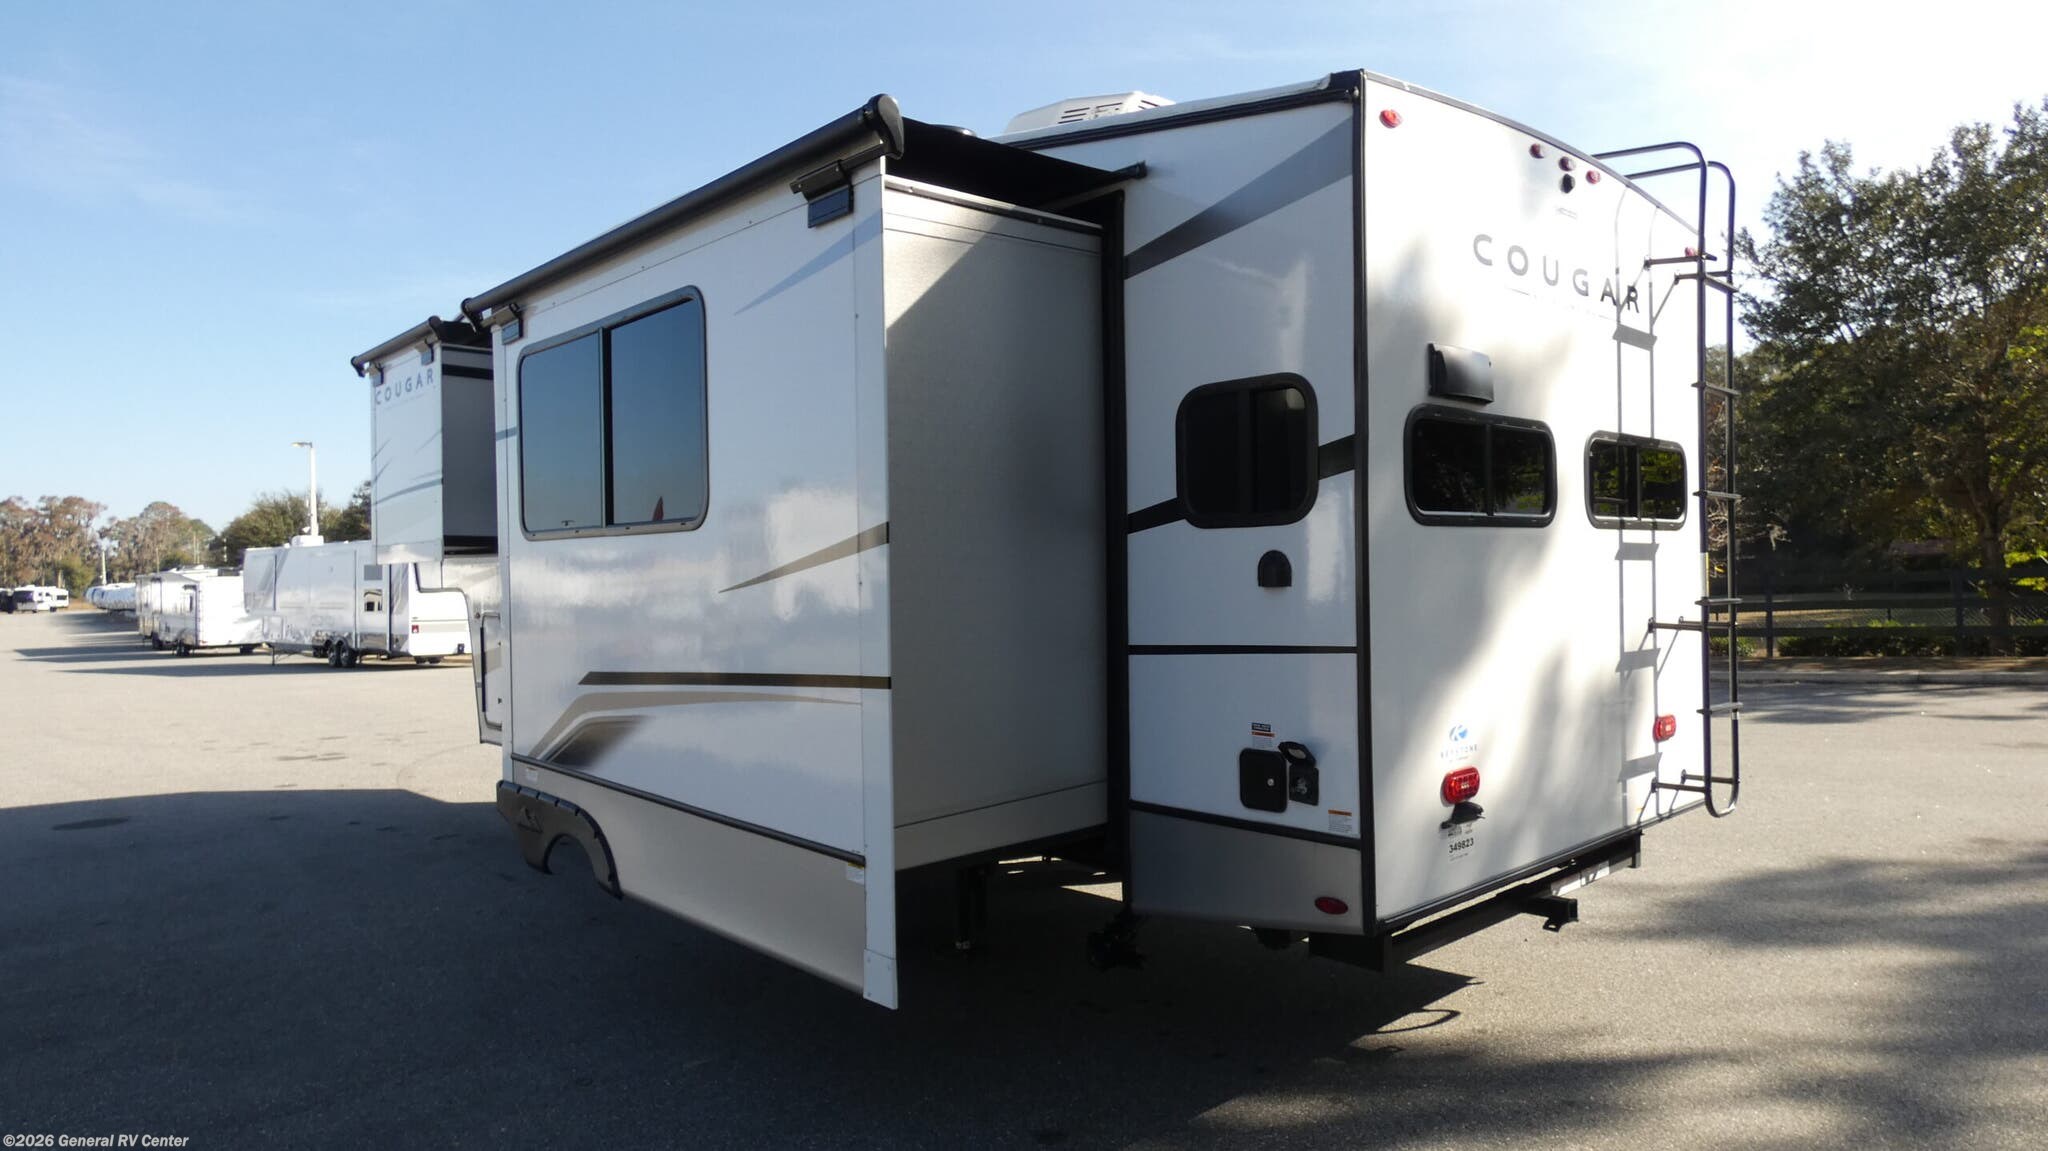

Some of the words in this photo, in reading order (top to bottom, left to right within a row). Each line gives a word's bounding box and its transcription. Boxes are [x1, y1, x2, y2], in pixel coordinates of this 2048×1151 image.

[1473, 233, 1640, 314] COUGAR
[375, 368, 434, 405] COUGAR
[1448, 837, 1474, 854] 349823
